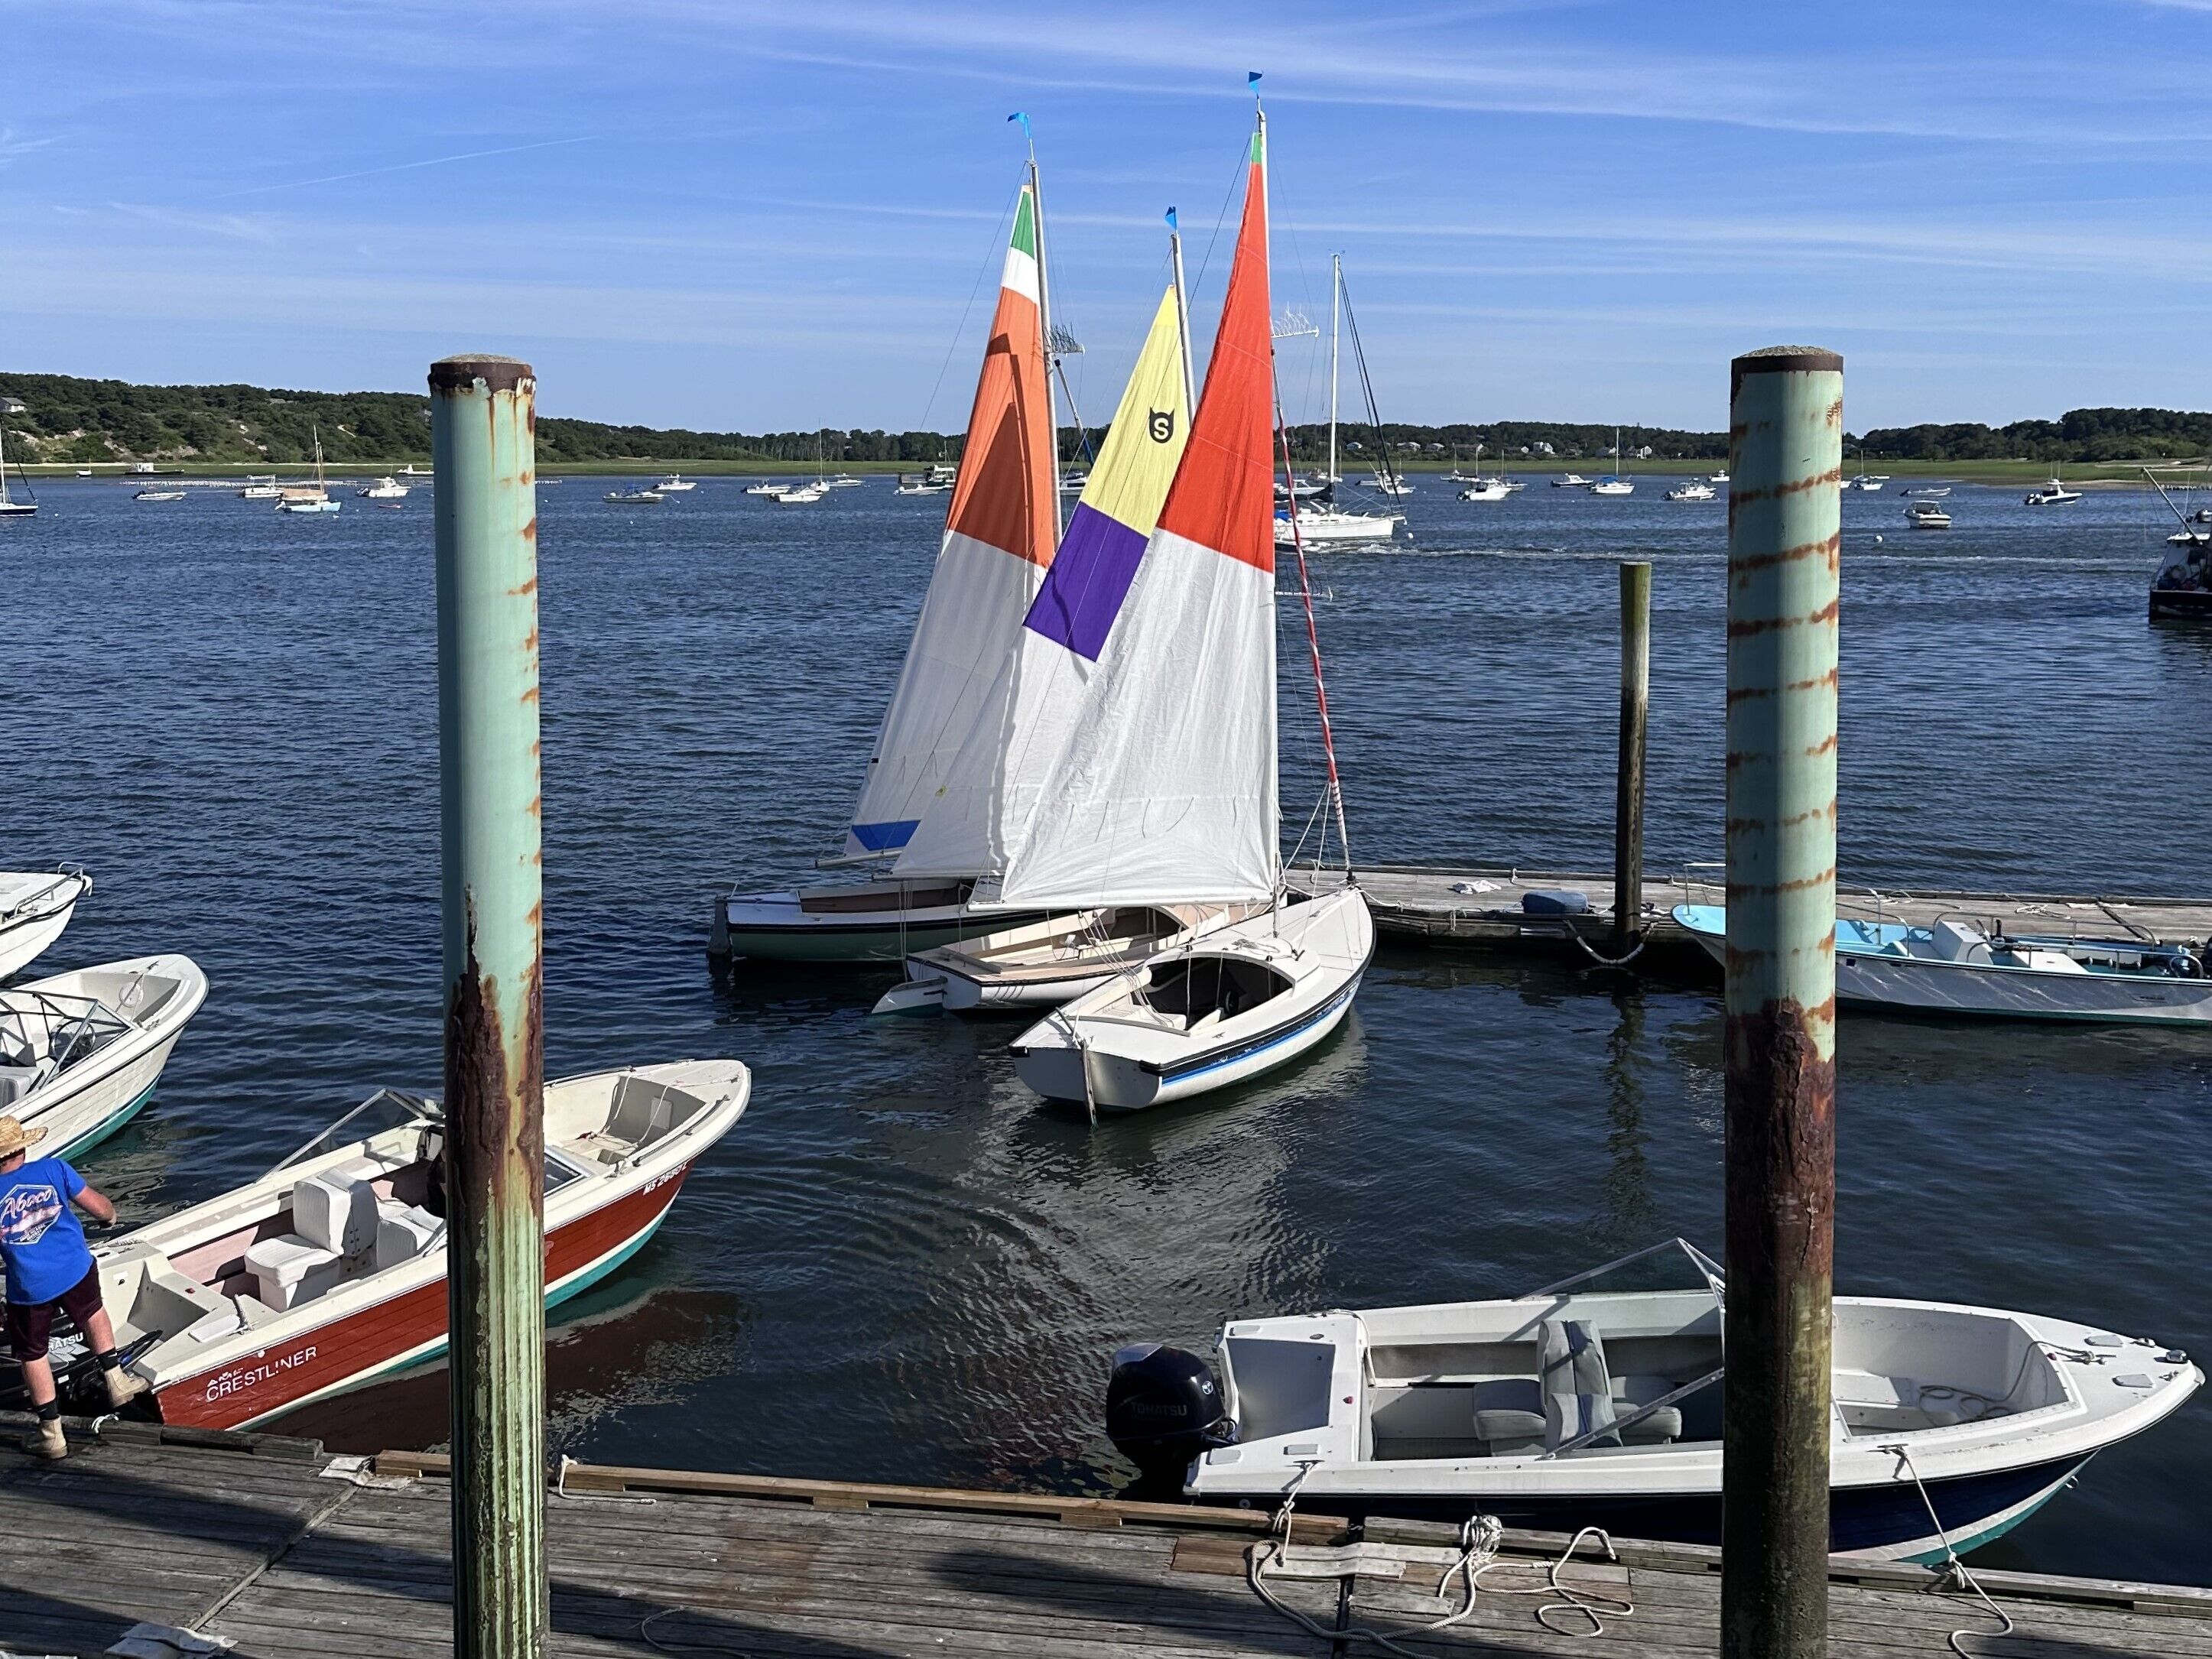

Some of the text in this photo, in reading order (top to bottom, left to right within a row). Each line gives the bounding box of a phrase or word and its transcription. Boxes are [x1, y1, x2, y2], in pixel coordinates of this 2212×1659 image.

[1154, 417, 1169, 440] S
[1, 1188, 52, 1228] Abaco
[48, 1332, 84, 1352] HATSU
[206, 1346, 317, 1402] CRESTLINER
[1131, 1401, 1188, 1417] TOHATSU
